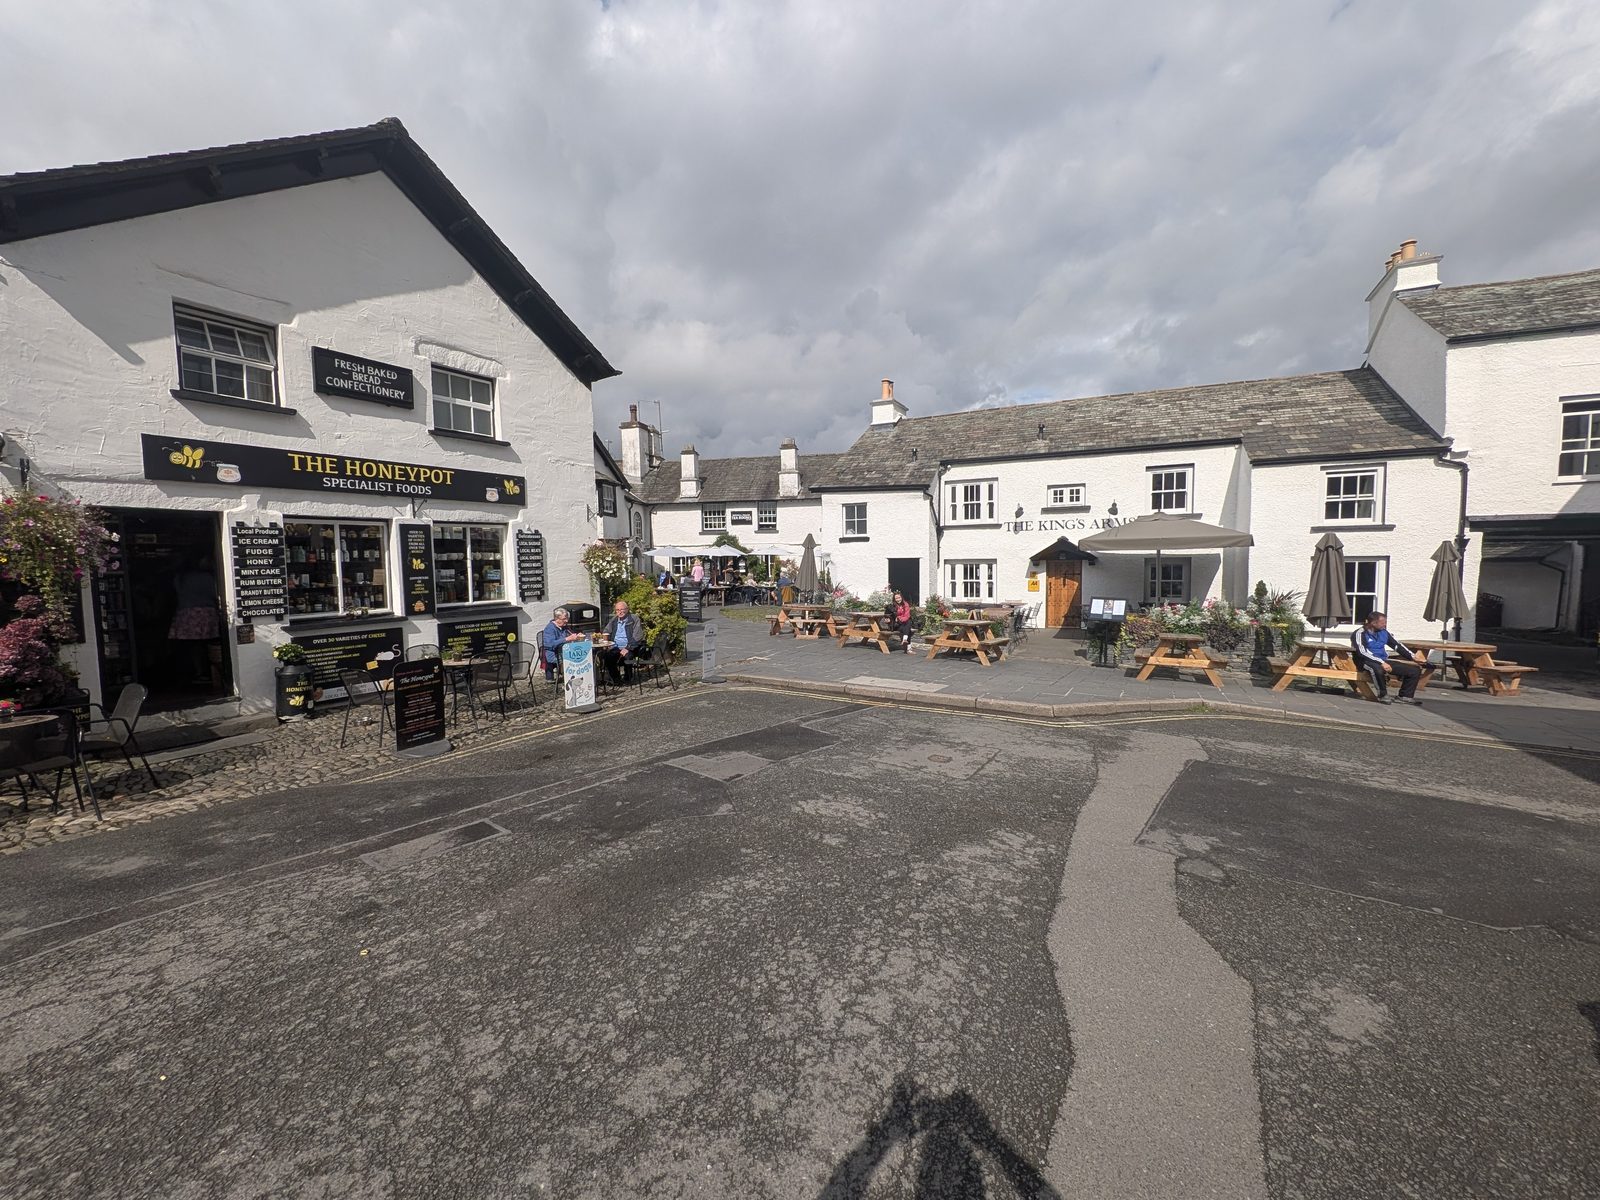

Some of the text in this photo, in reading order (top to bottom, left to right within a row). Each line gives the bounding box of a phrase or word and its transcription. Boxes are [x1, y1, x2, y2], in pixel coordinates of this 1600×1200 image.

[334, 358, 397, 380] FRESH BAKED
[352, 372, 380, 385] BREAD
[326, 376, 405, 400] CONFECTIONERY
[288, 453, 454, 485] THE HONEYPOT
[323, 478, 432, 495] SPECIALIST FOODS
[1004, 520, 1033, 532] THE
[1038, 518, 1085, 531] KING'S
[242, 608, 284, 616] CHOCOLATES
[569, 650, 588, 660] LAKES
[565, 663, 592, 675] for dogs
